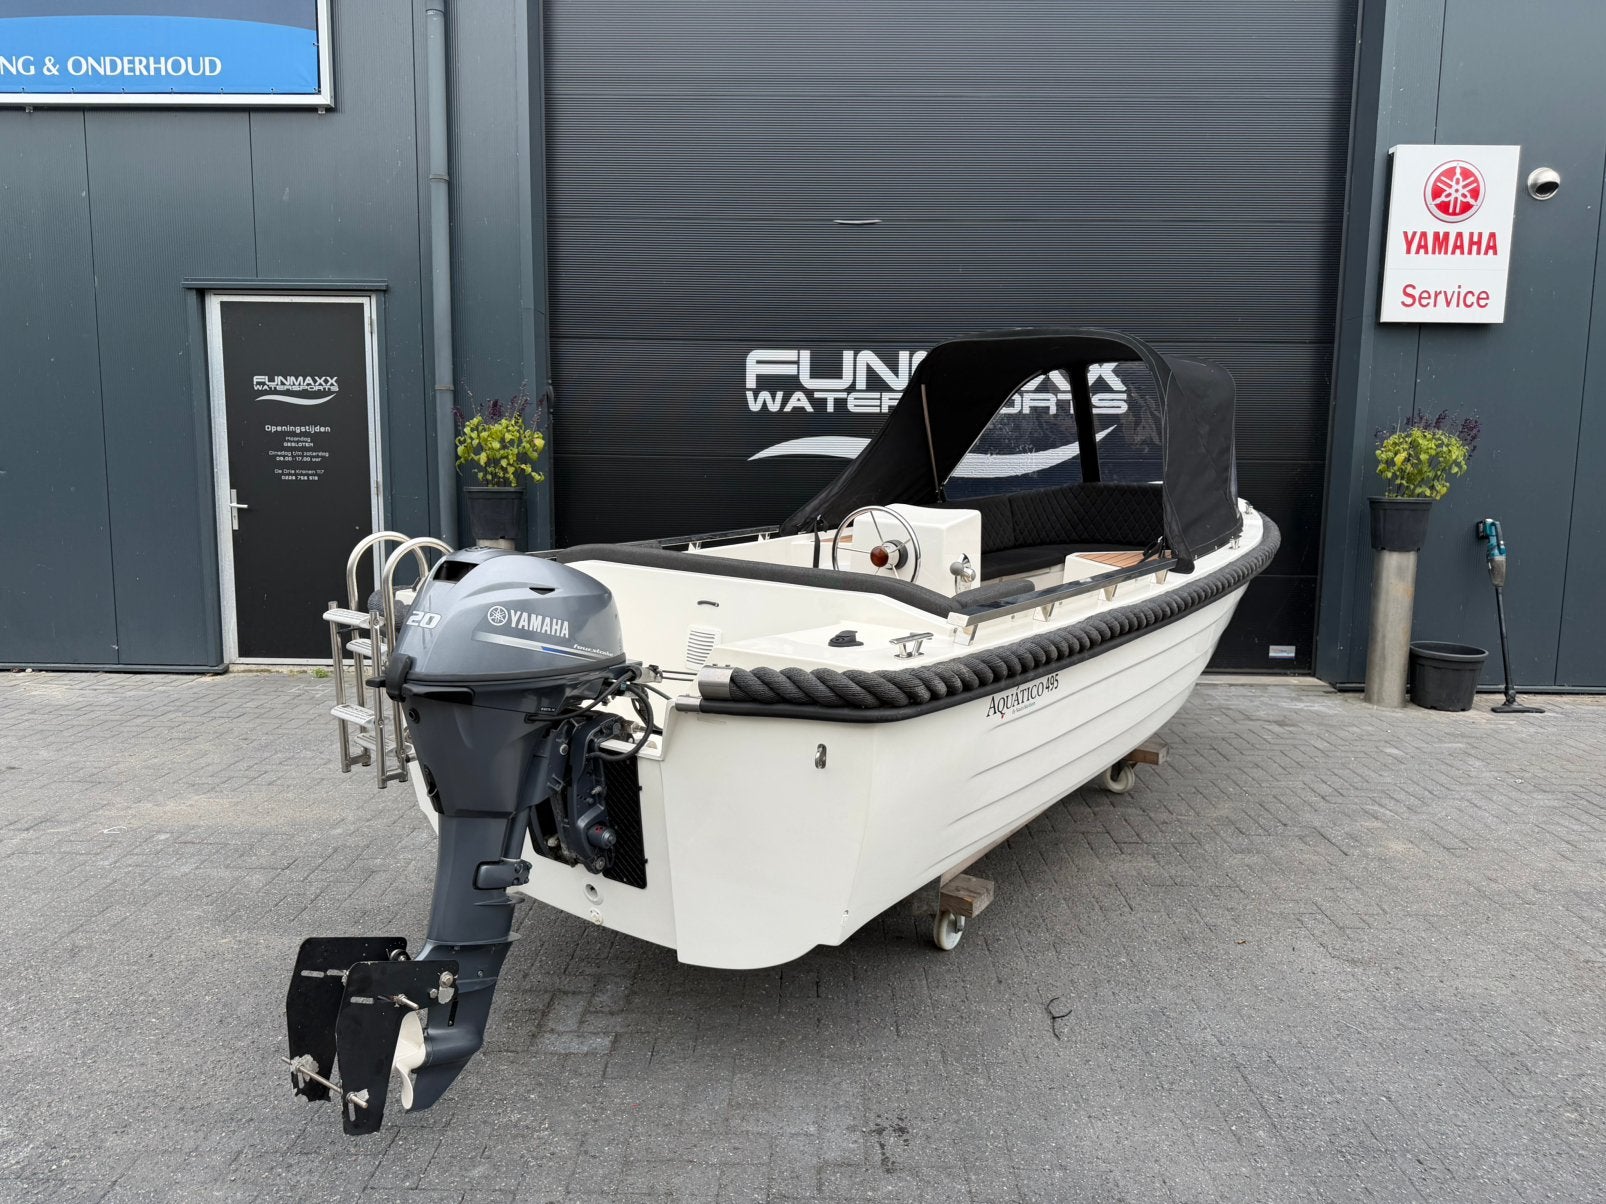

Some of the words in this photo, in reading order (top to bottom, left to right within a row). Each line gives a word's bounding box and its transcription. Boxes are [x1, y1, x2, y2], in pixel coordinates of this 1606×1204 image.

[42, 56, 60, 76] &
[67, 56, 222, 76] ONDERHOUD
[1403, 231, 1498, 256] YAMAHA
[1401, 284, 1489, 308] Service
[253, 376, 338, 386] FUNMAXX
[265, 425, 331, 433] Openingstijden
[406, 611, 442, 629] 20
[510, 610, 569, 638] YAMAHA
[1045, 674, 1059, 692] 495
